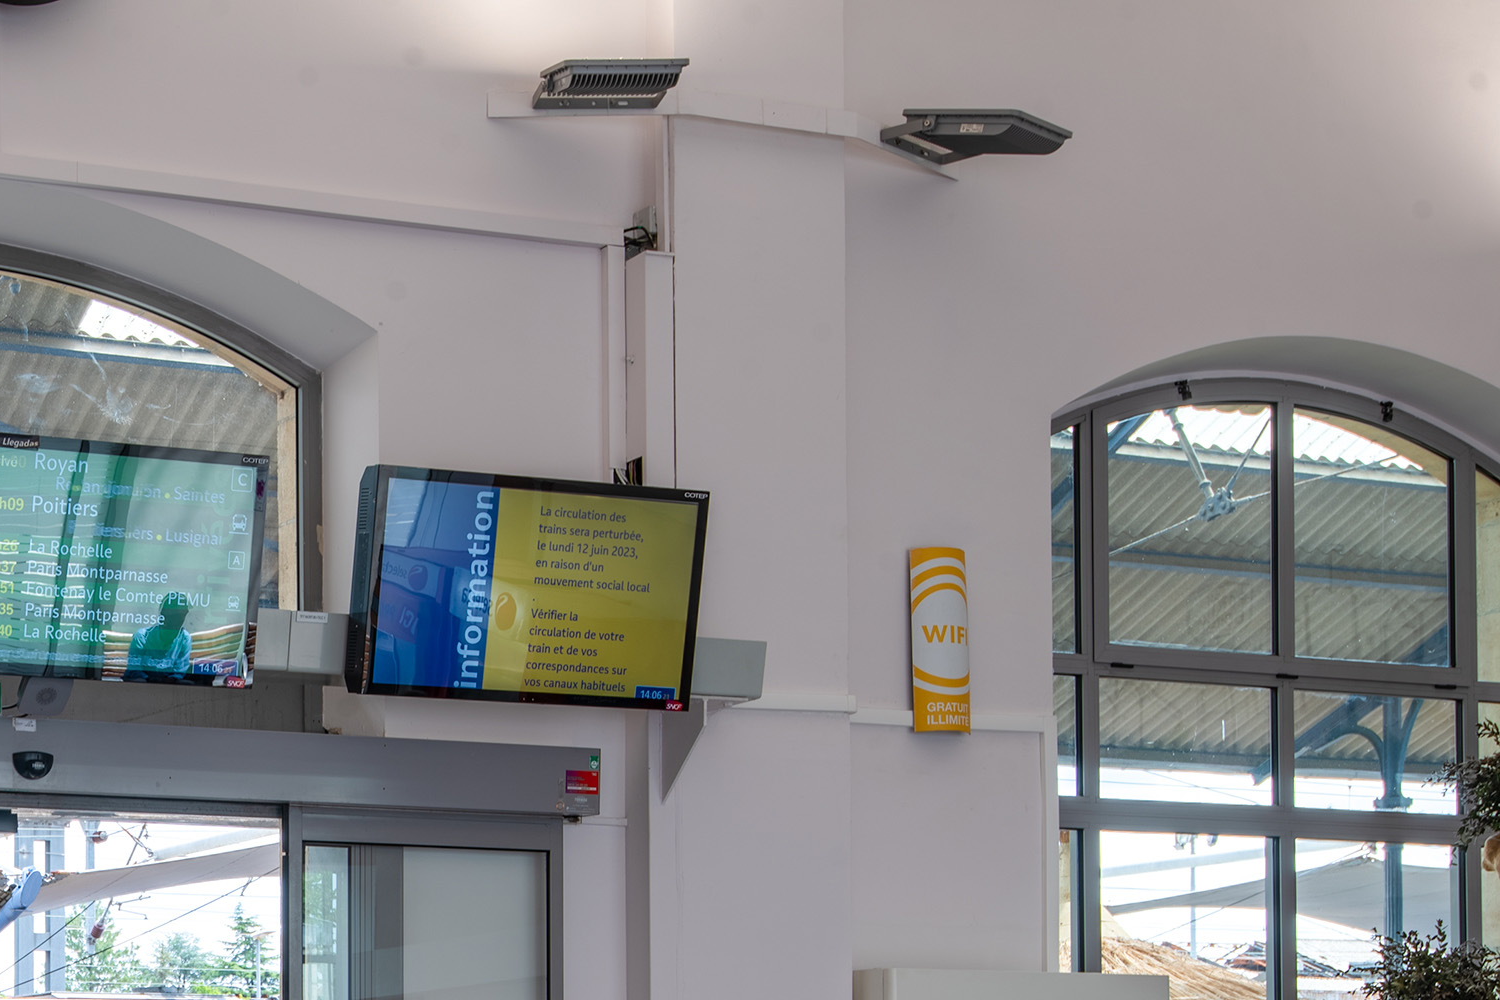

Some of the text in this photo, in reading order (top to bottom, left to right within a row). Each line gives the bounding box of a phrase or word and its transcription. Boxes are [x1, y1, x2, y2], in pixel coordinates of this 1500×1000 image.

[3, 437, 38, 448] Llegadas
[34, 452, 88, 476] Royan
[174, 486, 225, 504] Saintes
[32, 495, 99, 517] Poitiers
[540, 506, 626, 523] La circulation des
[539, 524, 644, 542] trains sera perturbée,
[29, 539, 113, 559] La Rochelle
[537, 540, 638, 559] le lundi 12 juin 2023,
[28, 560, 169, 585] Paris Montparnasse
[535, 560, 604, 572] en raison d'un
[454, 489, 495, 690] information
[534, 576, 650, 593] mouvement social local
[26, 581, 210, 607] Fontenay le Comte PEMU
[25, 602, 166, 626] Paris Montparnasse
[531, 608, 578, 622] Vérifier la
[24, 623, 107, 644] La Rochelle
[529, 626, 625, 642] circulation de votre
[922, 624, 968, 646] WIFI
[527, 643, 597, 657] train et de vos
[526, 661, 627, 675] correspondances sur
[524, 679, 625, 692] vos canaux habituels
[927, 702, 968, 714] GRATUIT
